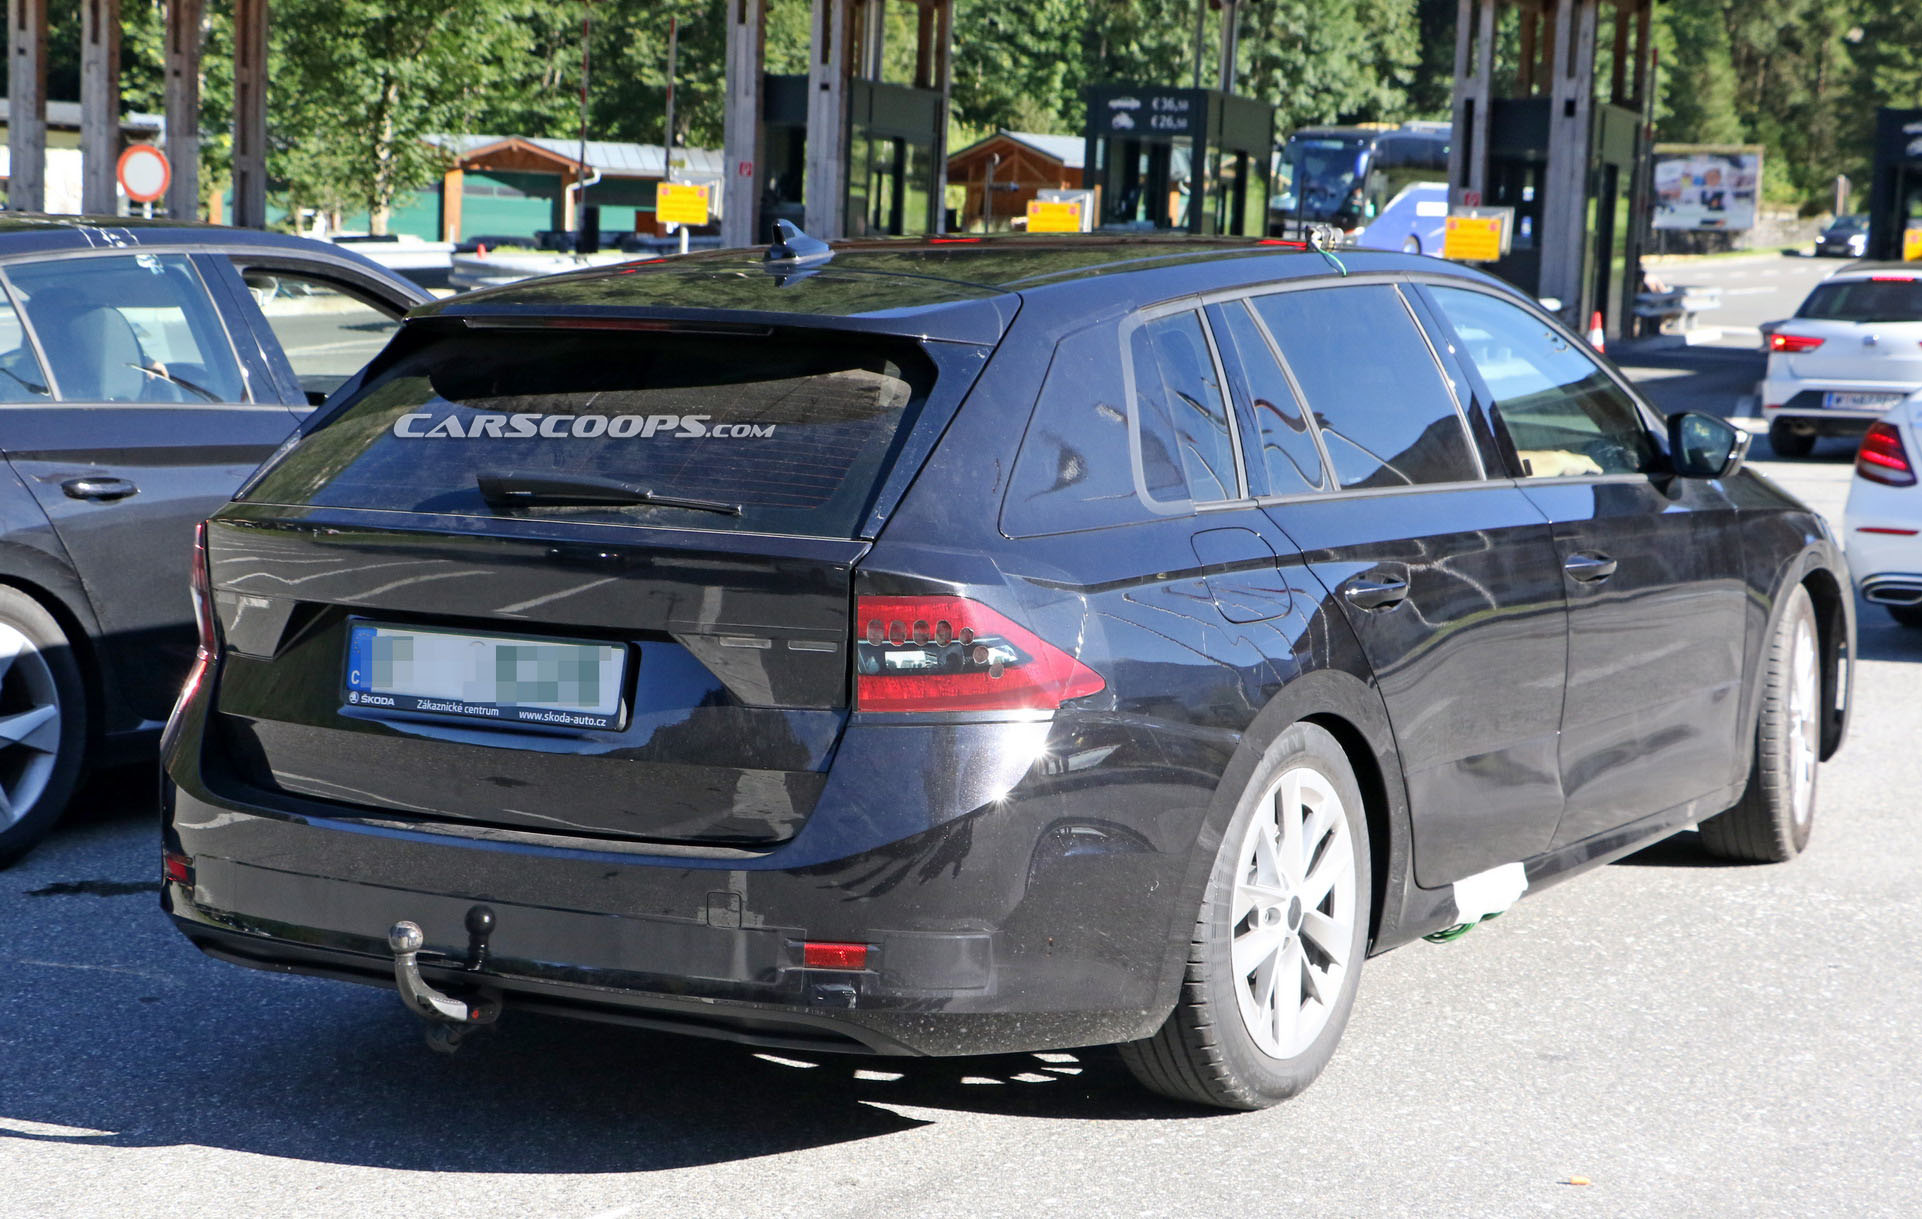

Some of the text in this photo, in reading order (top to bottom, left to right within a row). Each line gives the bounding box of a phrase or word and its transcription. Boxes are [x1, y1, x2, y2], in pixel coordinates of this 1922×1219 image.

[361, 693, 395, 706] ŠKODA
[417, 699, 499, 716] Zákaznické centrum
[518, 710, 607, 727] www.skoda-auto.cz
